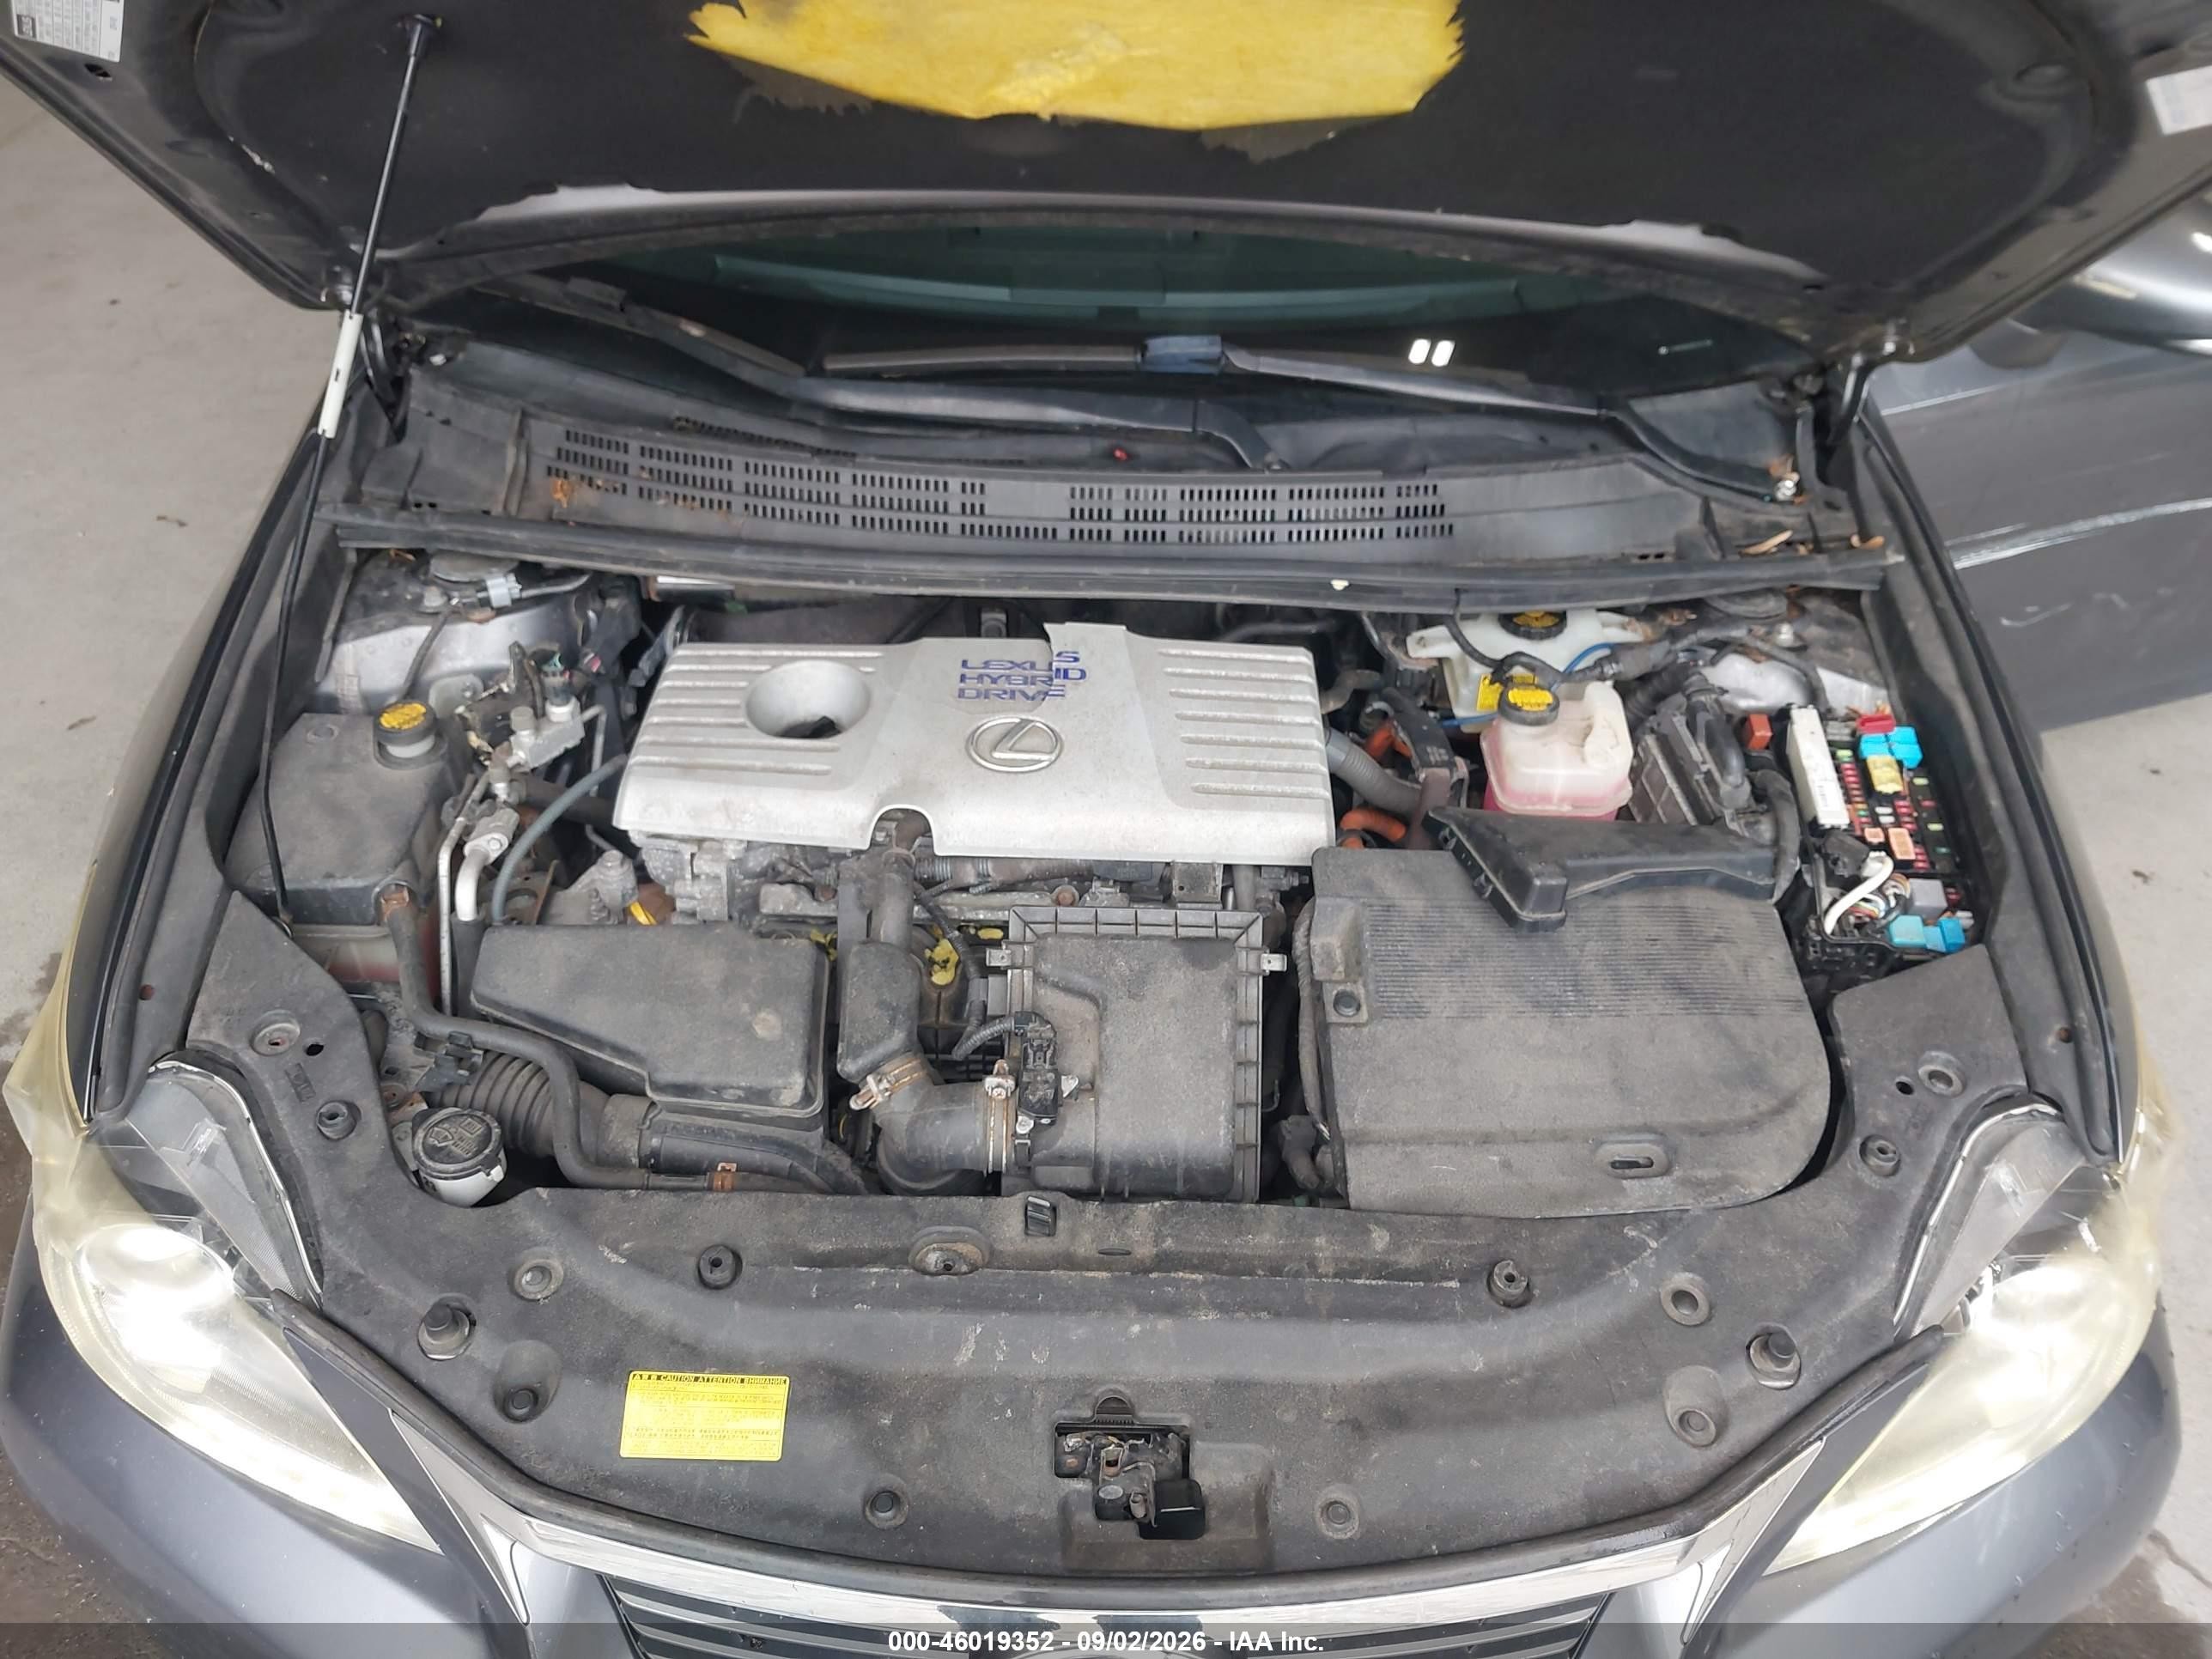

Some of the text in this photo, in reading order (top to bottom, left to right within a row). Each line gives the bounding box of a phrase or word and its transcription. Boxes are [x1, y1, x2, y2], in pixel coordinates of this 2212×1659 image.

[961, 651, 1080, 672] LEXUS
[959, 667, 1087, 687] HYBRID
[957, 684, 1066, 701] DRIVE
[659, 1374, 696, 1383] CAUTION
[698, 1376, 742, 1385] ATTENTION
